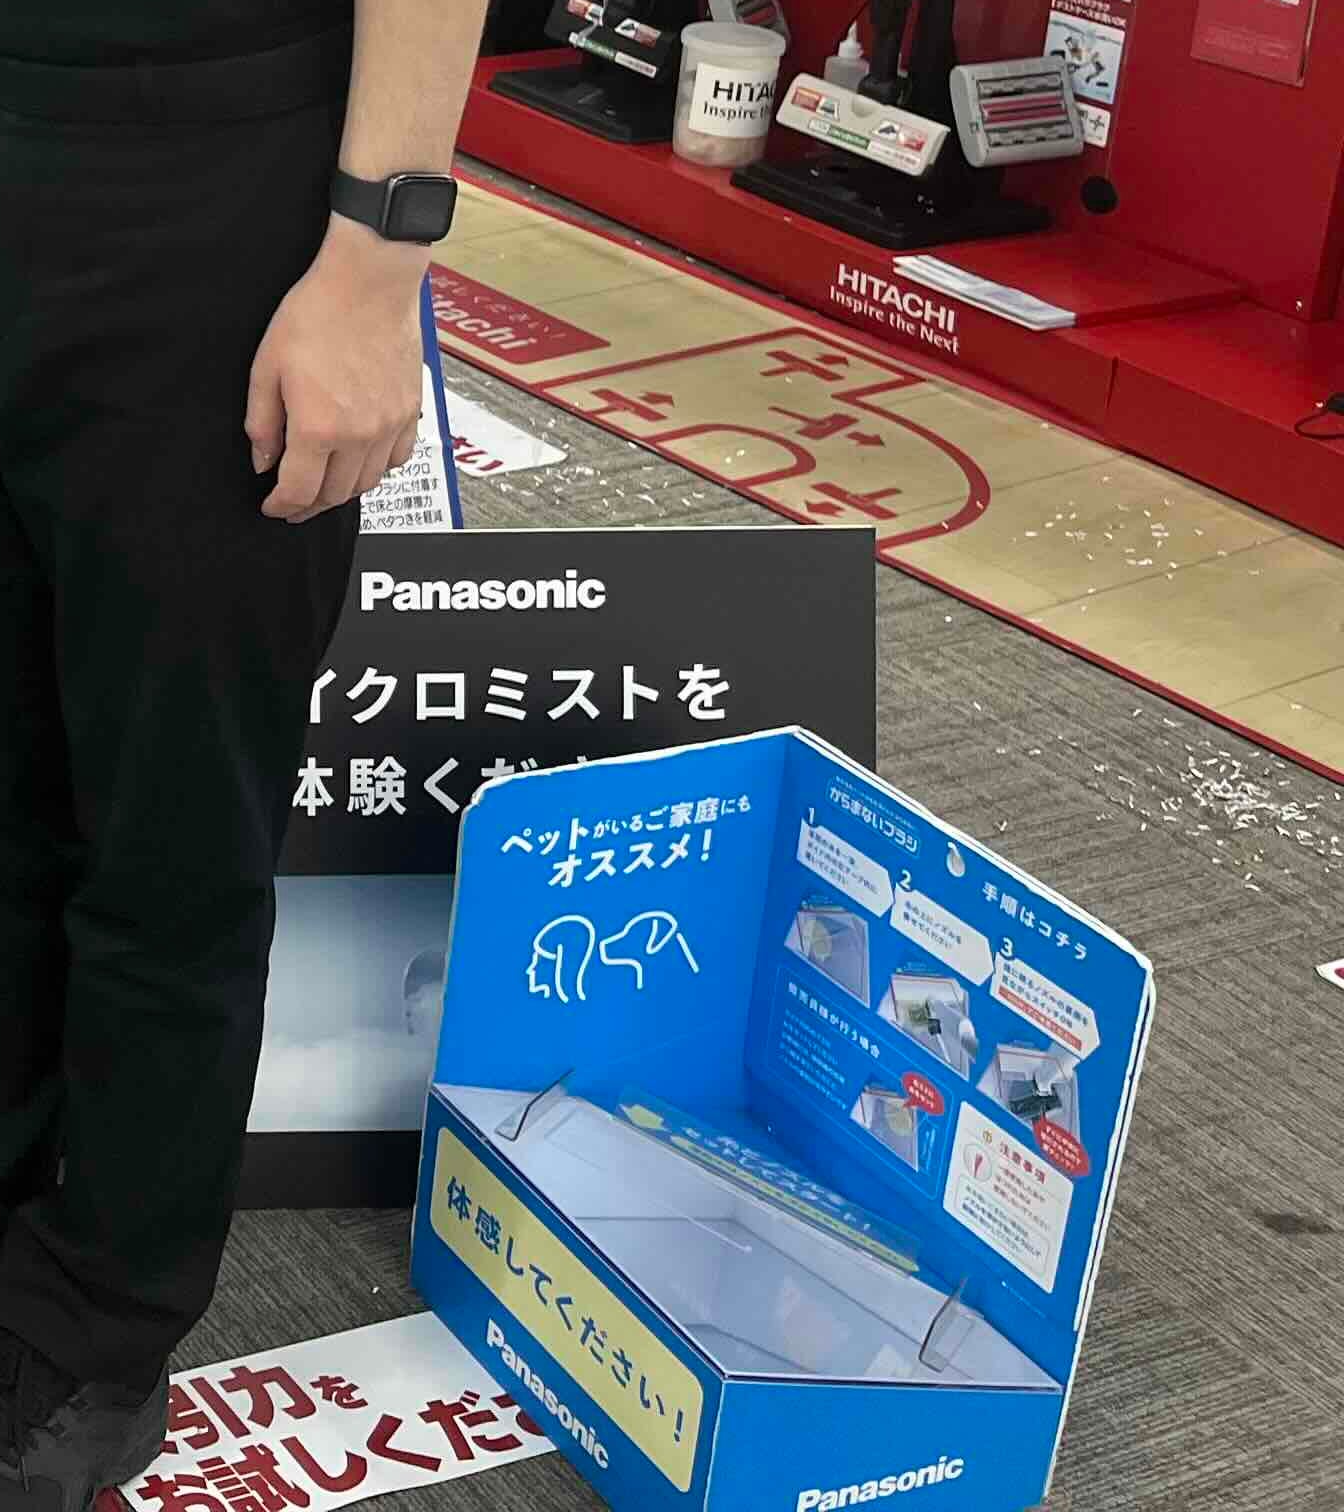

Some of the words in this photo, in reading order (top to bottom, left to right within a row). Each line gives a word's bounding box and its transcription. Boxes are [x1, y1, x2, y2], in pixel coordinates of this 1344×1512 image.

[829, 285, 892, 327] Inspire
[887, 308, 918, 338] the
[918, 322, 960, 357] Next
[836, 262, 957, 334] HITACHI
[360, 569, 606, 611] Panasonic
[501, 793, 753, 856] ペットがいるご家庭にも
[547, 827, 714, 889] オススメ!
[982, 881, 1088, 960] 手順はコチラ
[445, 1174, 686, 1445] 体感してください!
[485, 1316, 610, 1470] Panasonic
[795, 1454, 965, 1512] Panasonic
